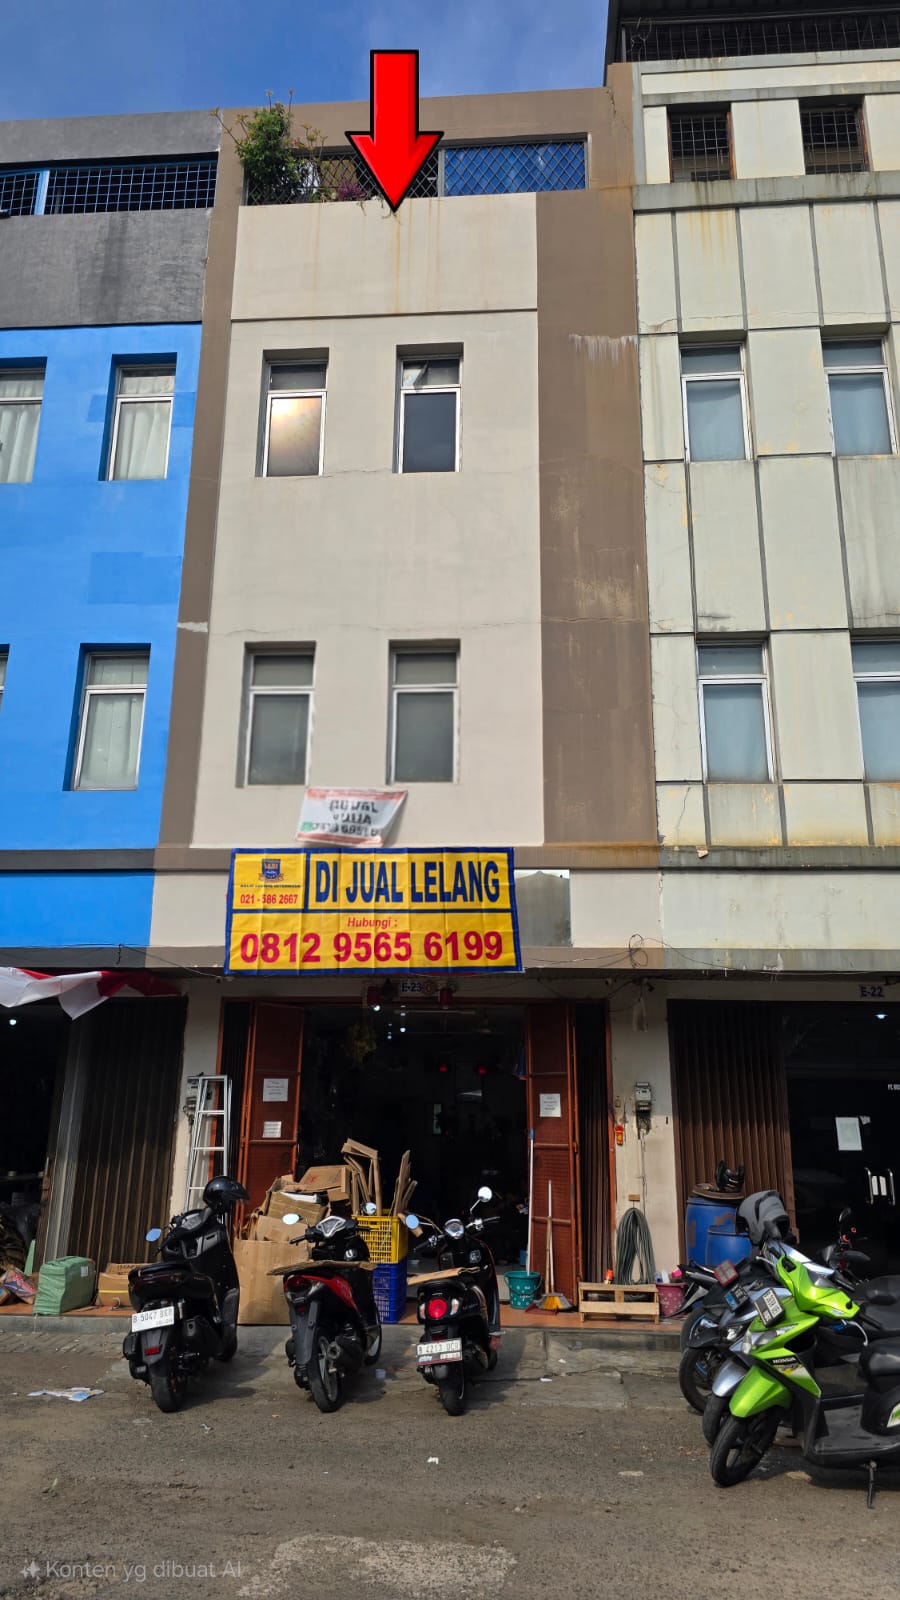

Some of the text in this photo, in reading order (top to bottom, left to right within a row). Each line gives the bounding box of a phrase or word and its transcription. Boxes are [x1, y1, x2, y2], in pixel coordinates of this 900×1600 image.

[315, 860, 500, 903] DI JUAL LELANG
[240, 893, 255, 904] 021
[279, 893, 298, 904] 2667
[347, 916, 392, 929] Hubungi
[240, 931, 503, 963] 0812 9565 6199
[402, 982, 421, 992] E-23
